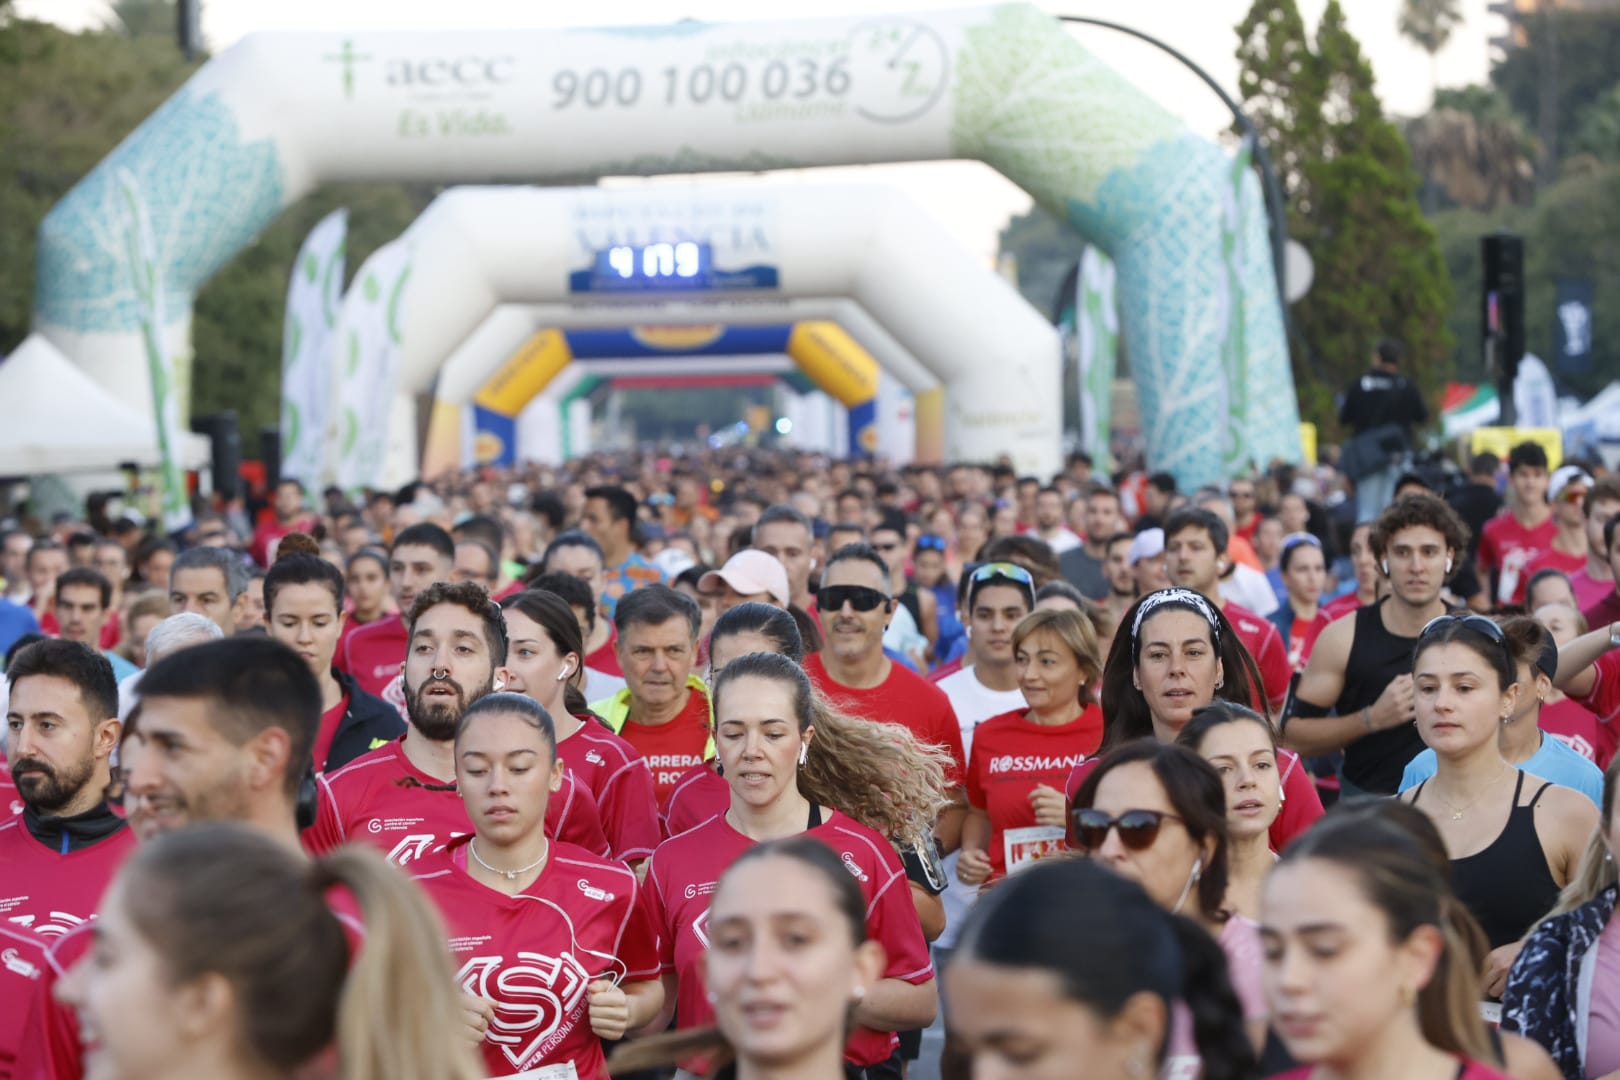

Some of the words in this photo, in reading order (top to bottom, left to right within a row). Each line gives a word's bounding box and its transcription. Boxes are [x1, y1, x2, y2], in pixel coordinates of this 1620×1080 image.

[385, 55, 515, 87] aecc
[551, 67, 641, 111] 900
[662, 61, 749, 107] 100
[762, 55, 853, 100] 036
[642, 754, 704, 768] ARRERA
[658, 771, 686, 785] RO
[541, 1020, 575, 1055] PERSONA
